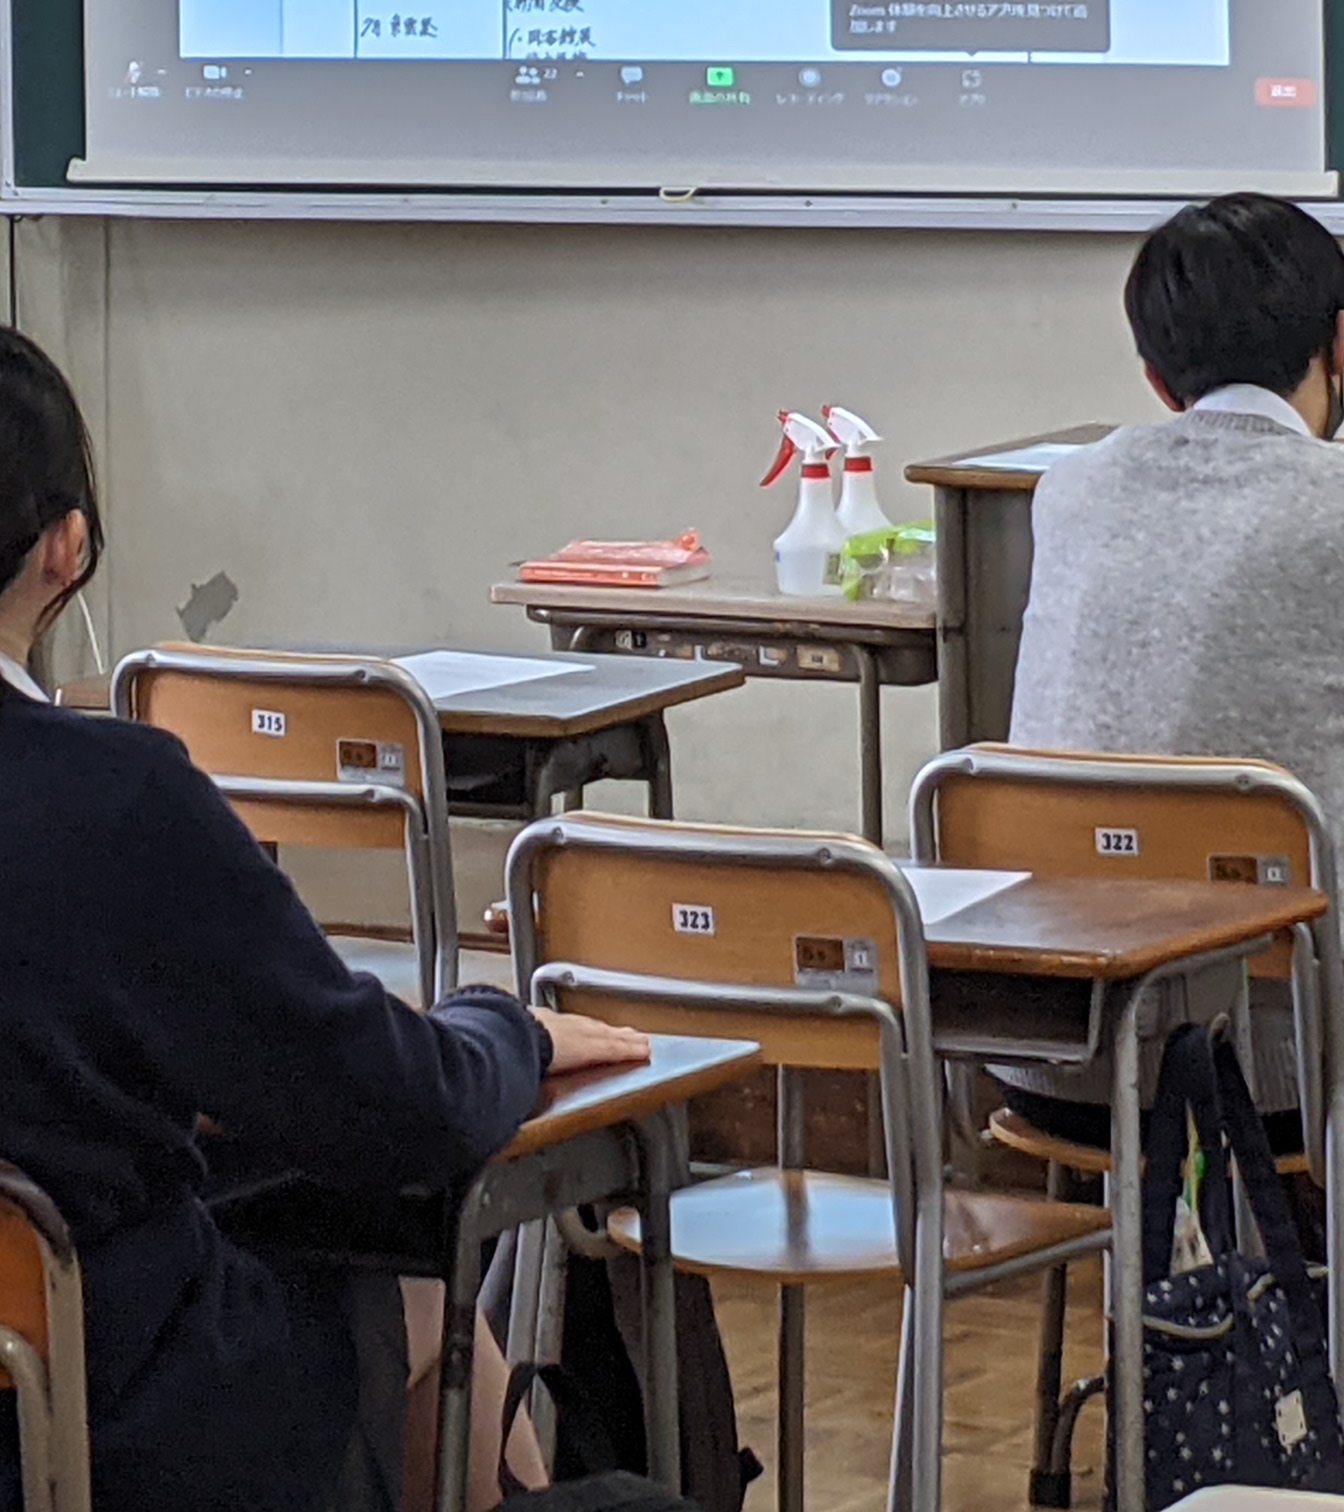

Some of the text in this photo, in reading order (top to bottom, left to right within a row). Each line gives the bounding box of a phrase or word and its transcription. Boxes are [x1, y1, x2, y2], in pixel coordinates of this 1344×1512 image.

[257, 714, 283, 732] 315
[1101, 833, 1134, 851] 322
[678, 909, 711, 930] 323
